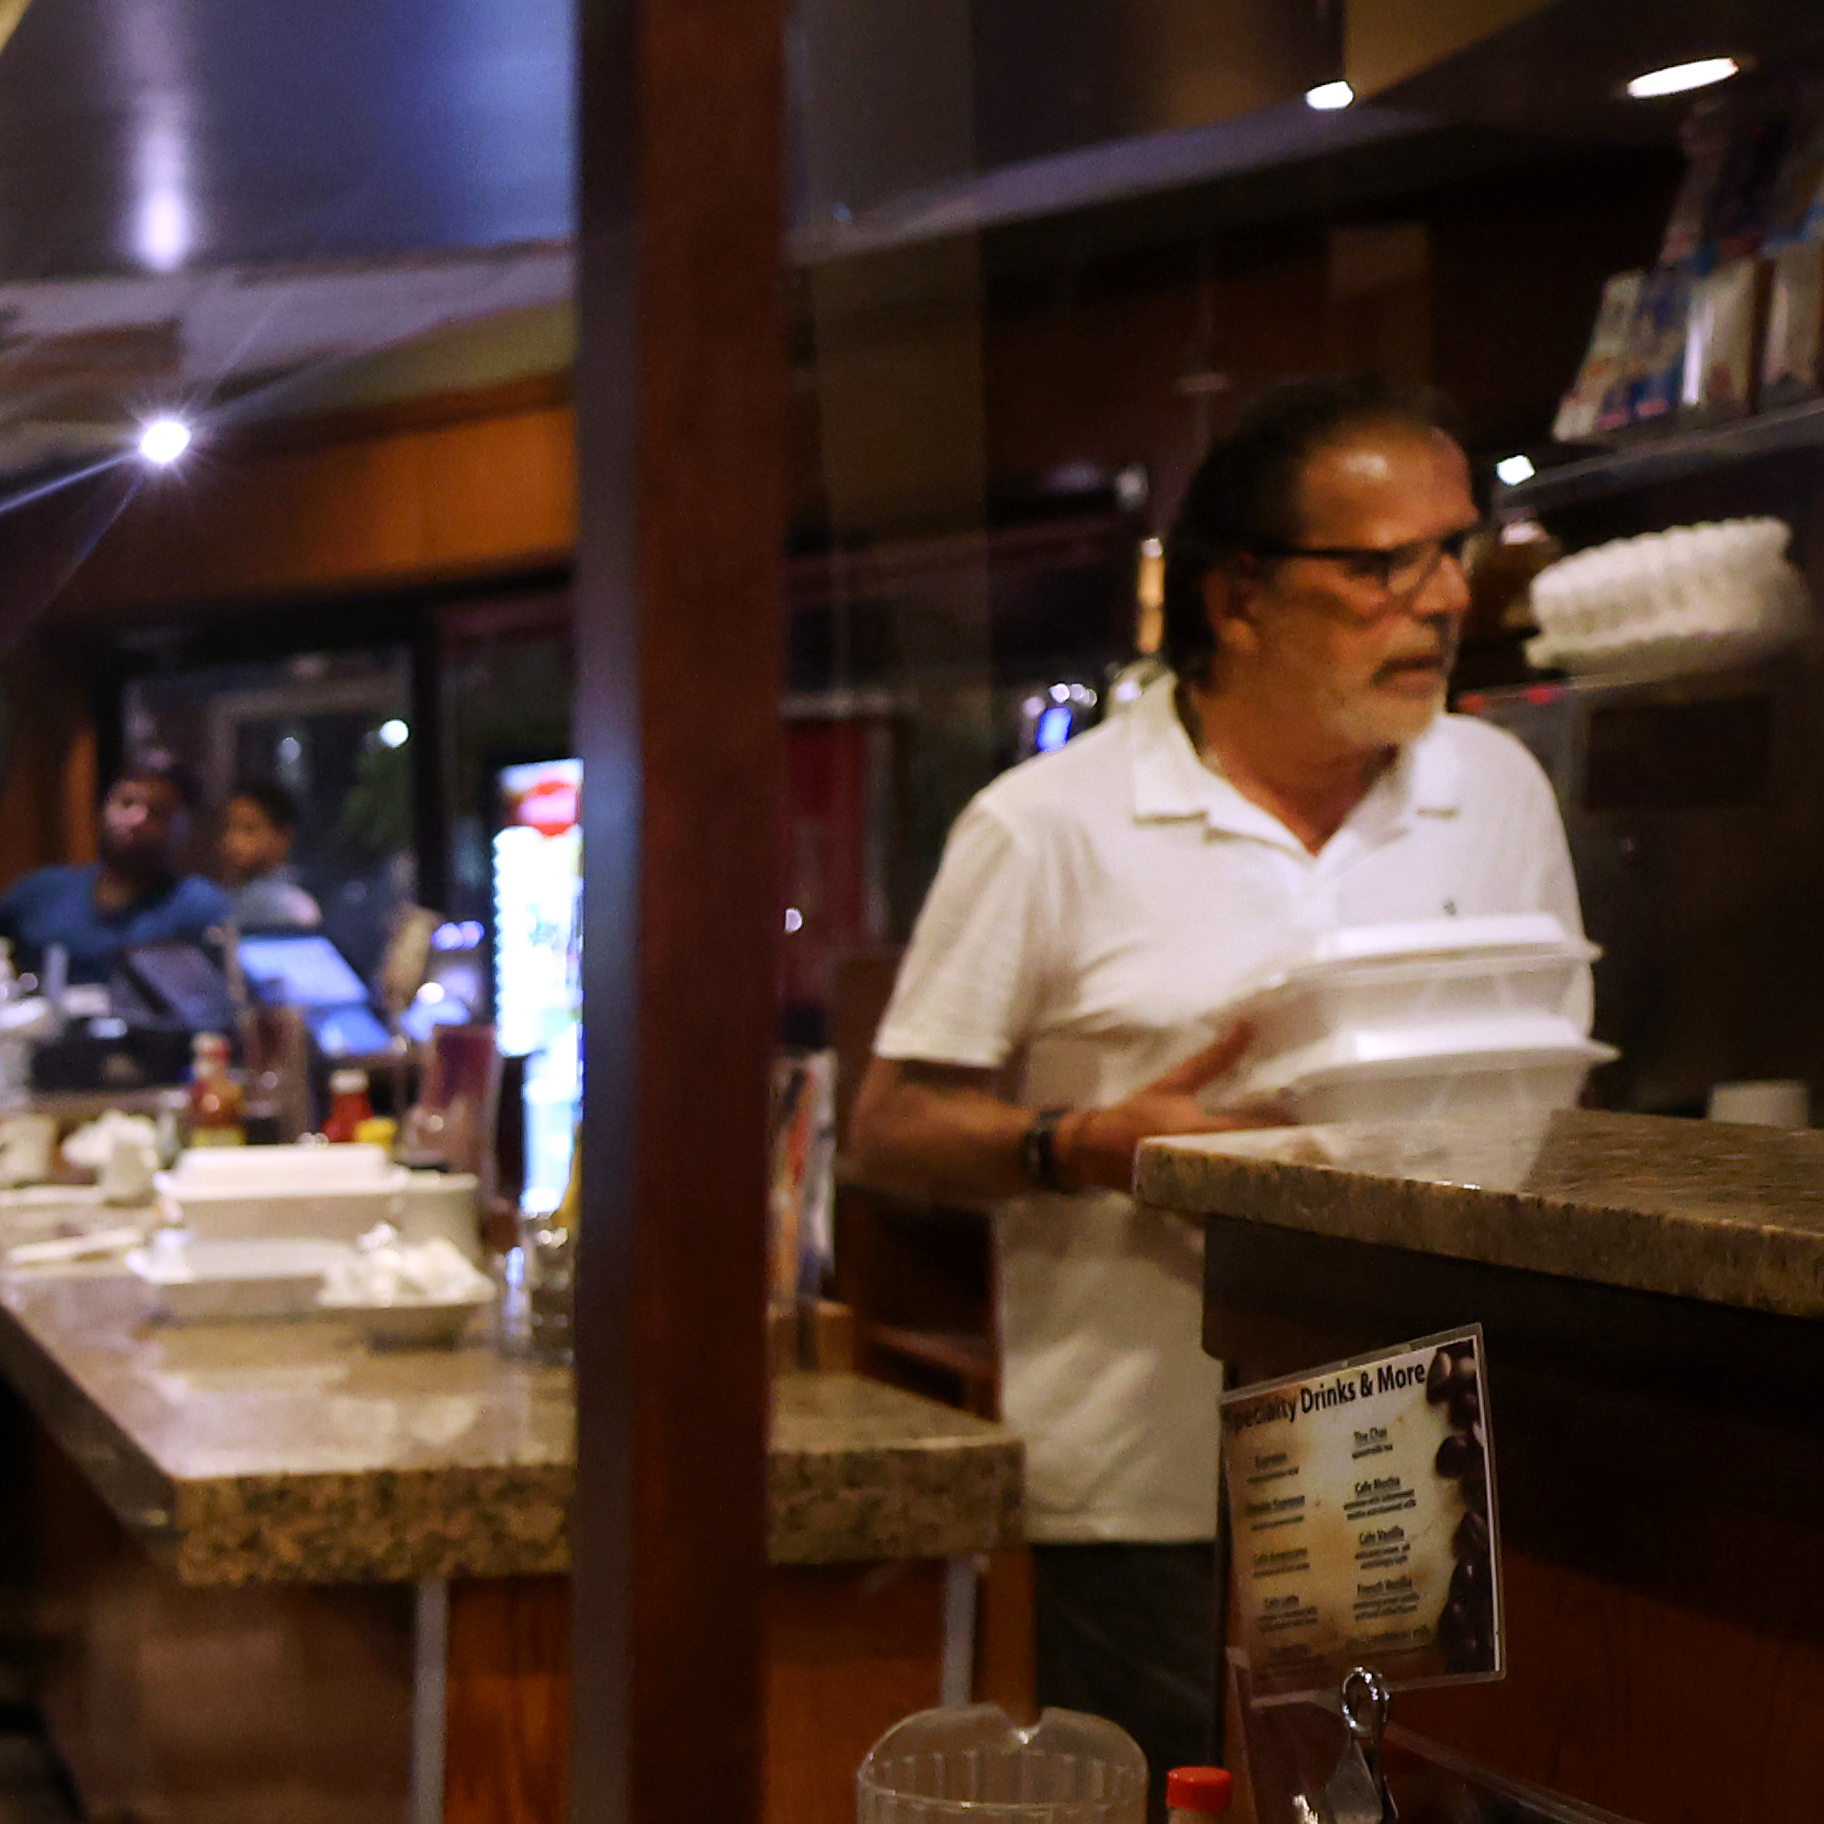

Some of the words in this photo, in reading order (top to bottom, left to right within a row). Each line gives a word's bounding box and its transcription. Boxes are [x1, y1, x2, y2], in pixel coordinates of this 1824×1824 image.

[1301, 1378, 1355, 1413] Drinks
[1360, 1372, 1373, 1396] &
[1377, 1363, 1426, 1392] More
